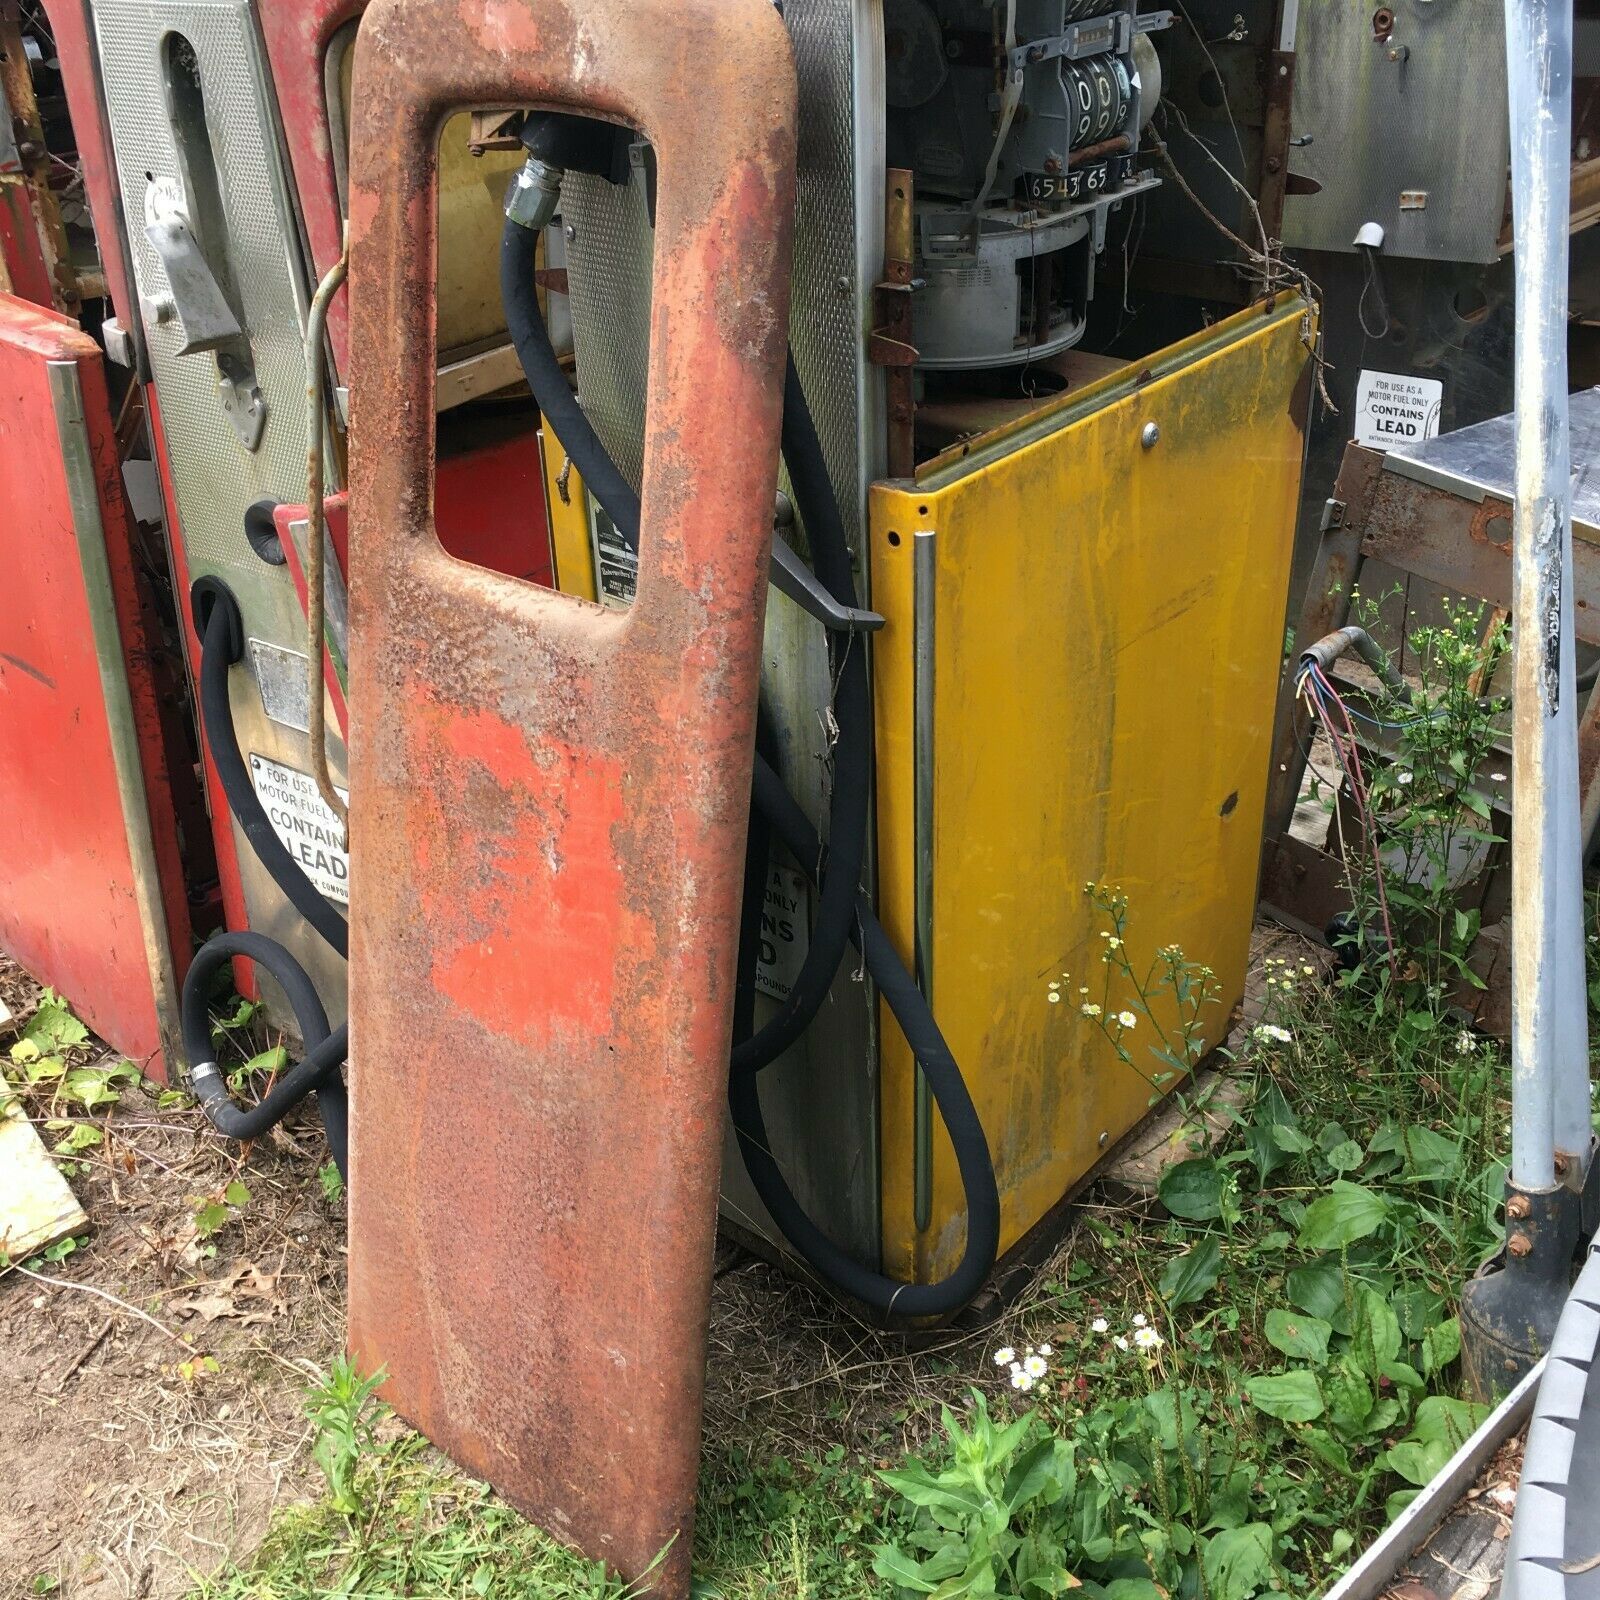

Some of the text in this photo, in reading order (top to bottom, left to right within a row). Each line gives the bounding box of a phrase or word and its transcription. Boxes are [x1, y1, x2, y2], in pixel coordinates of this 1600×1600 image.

[1376, 381, 1423, 395] FOR USE AS A
[1368, 390, 1429, 407] MOTOR FUEL ONLY
[1371, 404, 1424, 420] CONTAINS
[1376, 418, 1416, 436] LEAD
[266, 767, 289, 787] FOR
[292, 778, 313, 796] USE
[259, 781, 297, 808] MOTOR
[300, 798, 328, 820] FUEL
[270, 807, 344, 849] CONTAIN
[286, 837, 347, 880] LEAD
[772, 871, 782, 888] A
[755, 972, 792, 994] POUNDS
